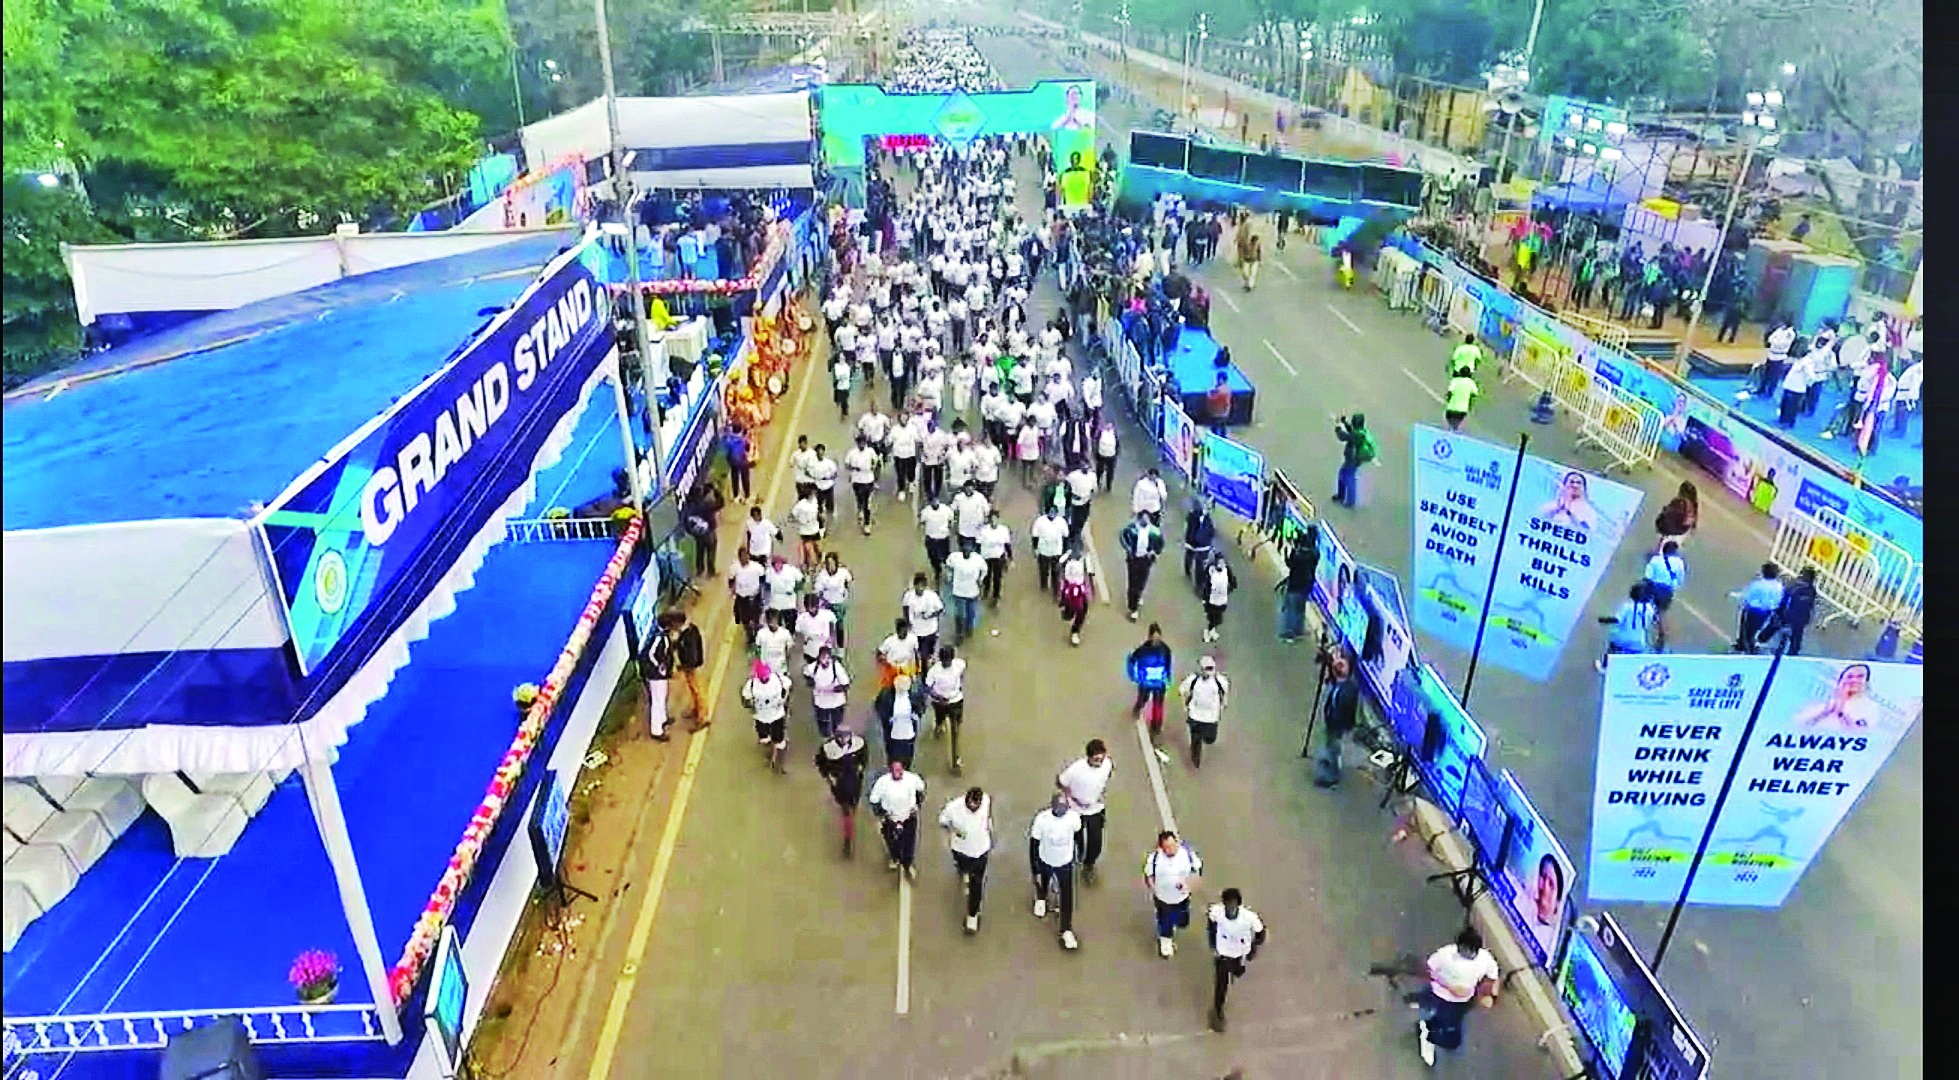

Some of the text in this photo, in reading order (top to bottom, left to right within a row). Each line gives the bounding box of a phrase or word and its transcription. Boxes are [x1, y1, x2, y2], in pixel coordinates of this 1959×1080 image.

[360, 278, 592, 546] GRAND STAND
[1446, 489, 1477, 510] USE
[1420, 499, 1498, 535] SEATBELT
[1430, 522, 1478, 547] AVIOD
[1529, 517, 1587, 545] SPEED
[1425, 538, 1476, 566] DEATH
[1518, 533, 1591, 567] THRILLS
[1531, 557, 1567, 578] BUT
[1520, 573, 1570, 599] KILLS
[1639, 724, 1722, 740] NEVER
[1765, 733, 1868, 751] ALWAYS
[1634, 747, 1711, 762] DRINK
[1773, 757, 1844, 773] WEAR
[1628, 769, 1703, 784] WHILE
[1748, 778, 1850, 795] HELMET
[1608, 791, 1706, 806] DRIVING
